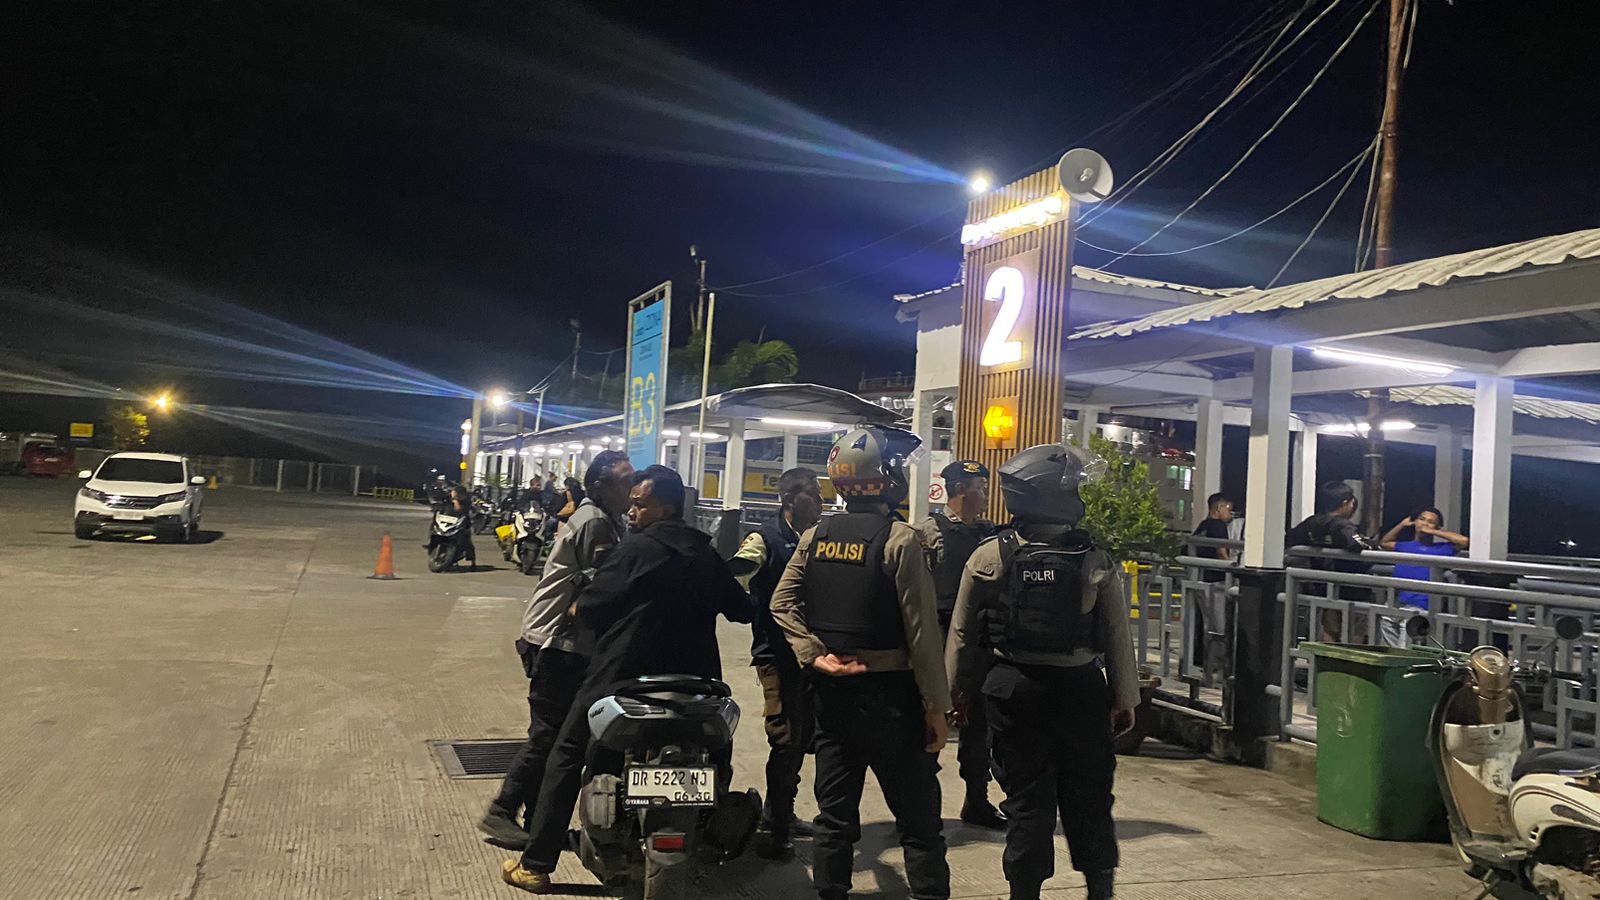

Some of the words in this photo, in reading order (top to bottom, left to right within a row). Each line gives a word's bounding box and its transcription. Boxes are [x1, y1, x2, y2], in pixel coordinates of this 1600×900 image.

[980, 266, 1025, 367] 2
[628, 371, 656, 437] B3
[815, 541, 864, 560] POLISI
[1023, 570, 1055, 581] POLRI
[632, 771, 648, 786] DR
[654, 771, 686, 786] 5222
[691, 771, 707, 786] NJ
